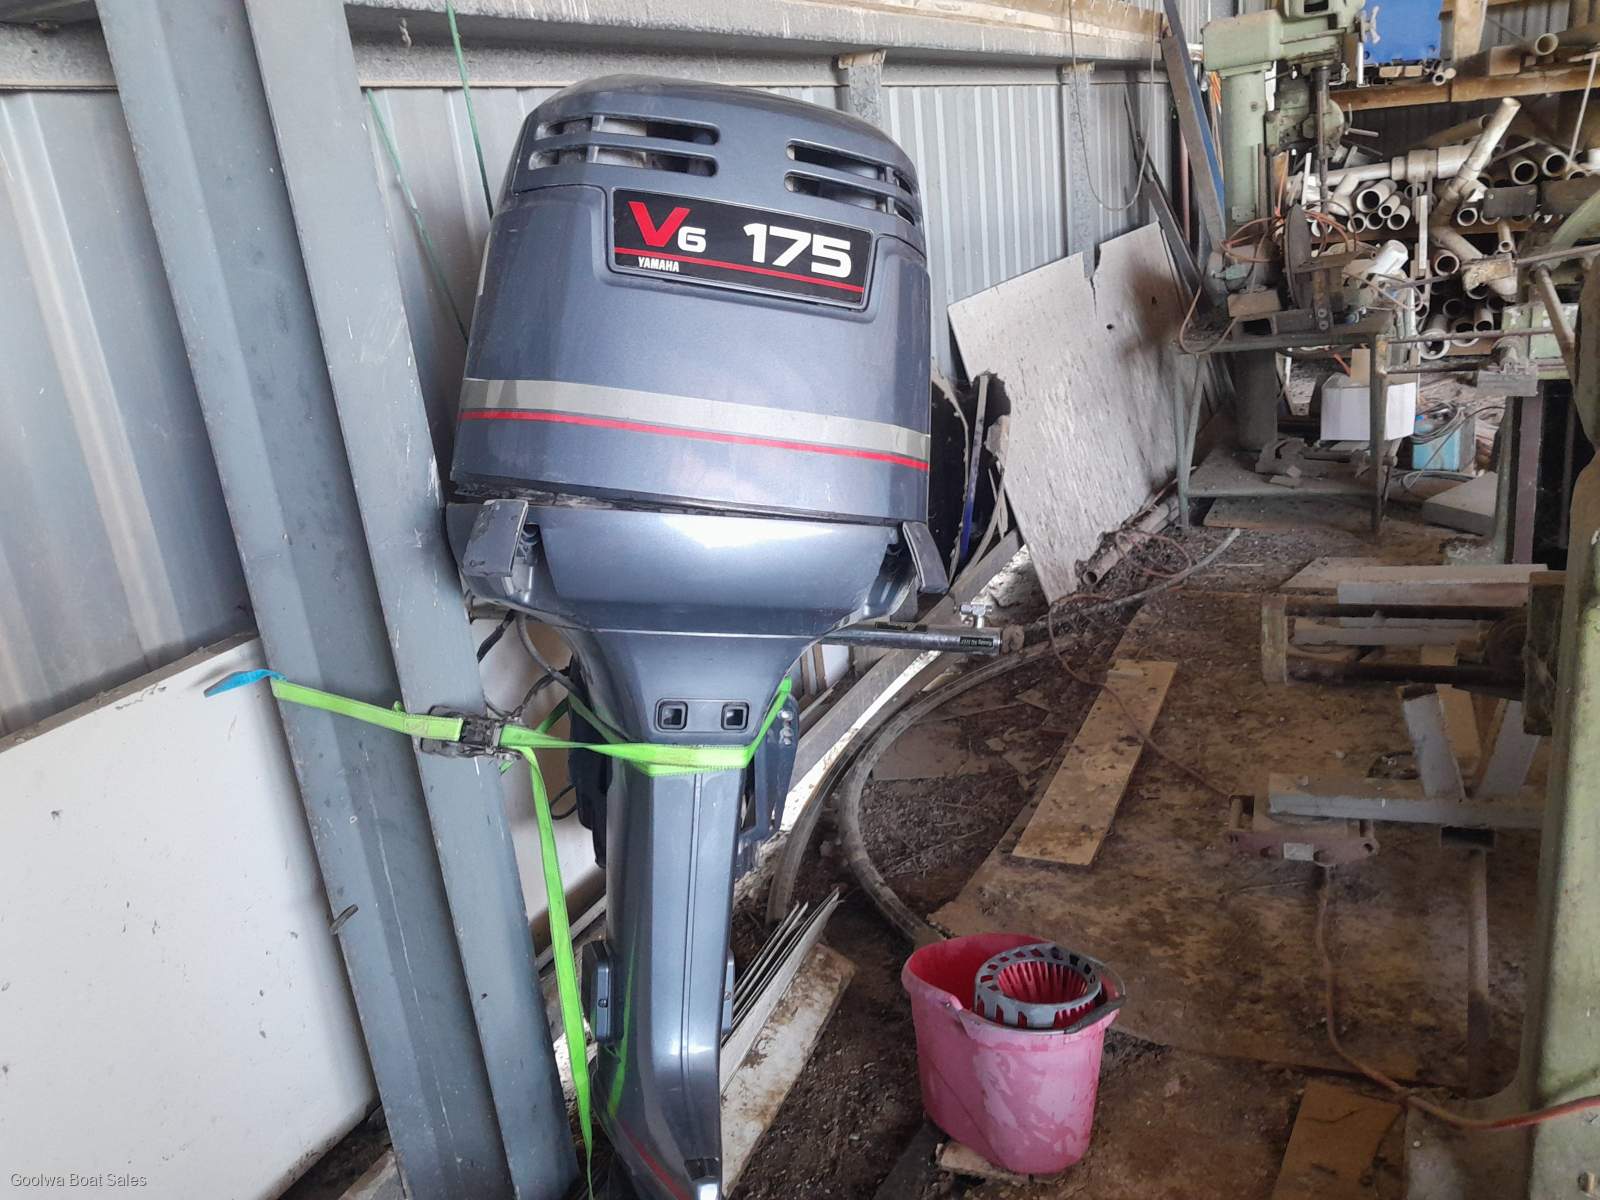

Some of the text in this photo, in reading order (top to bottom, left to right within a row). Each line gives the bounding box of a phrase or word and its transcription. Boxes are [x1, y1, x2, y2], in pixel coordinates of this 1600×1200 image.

[628, 201, 852, 278] V6 175
[638, 256, 680, 273] YAMAHA
